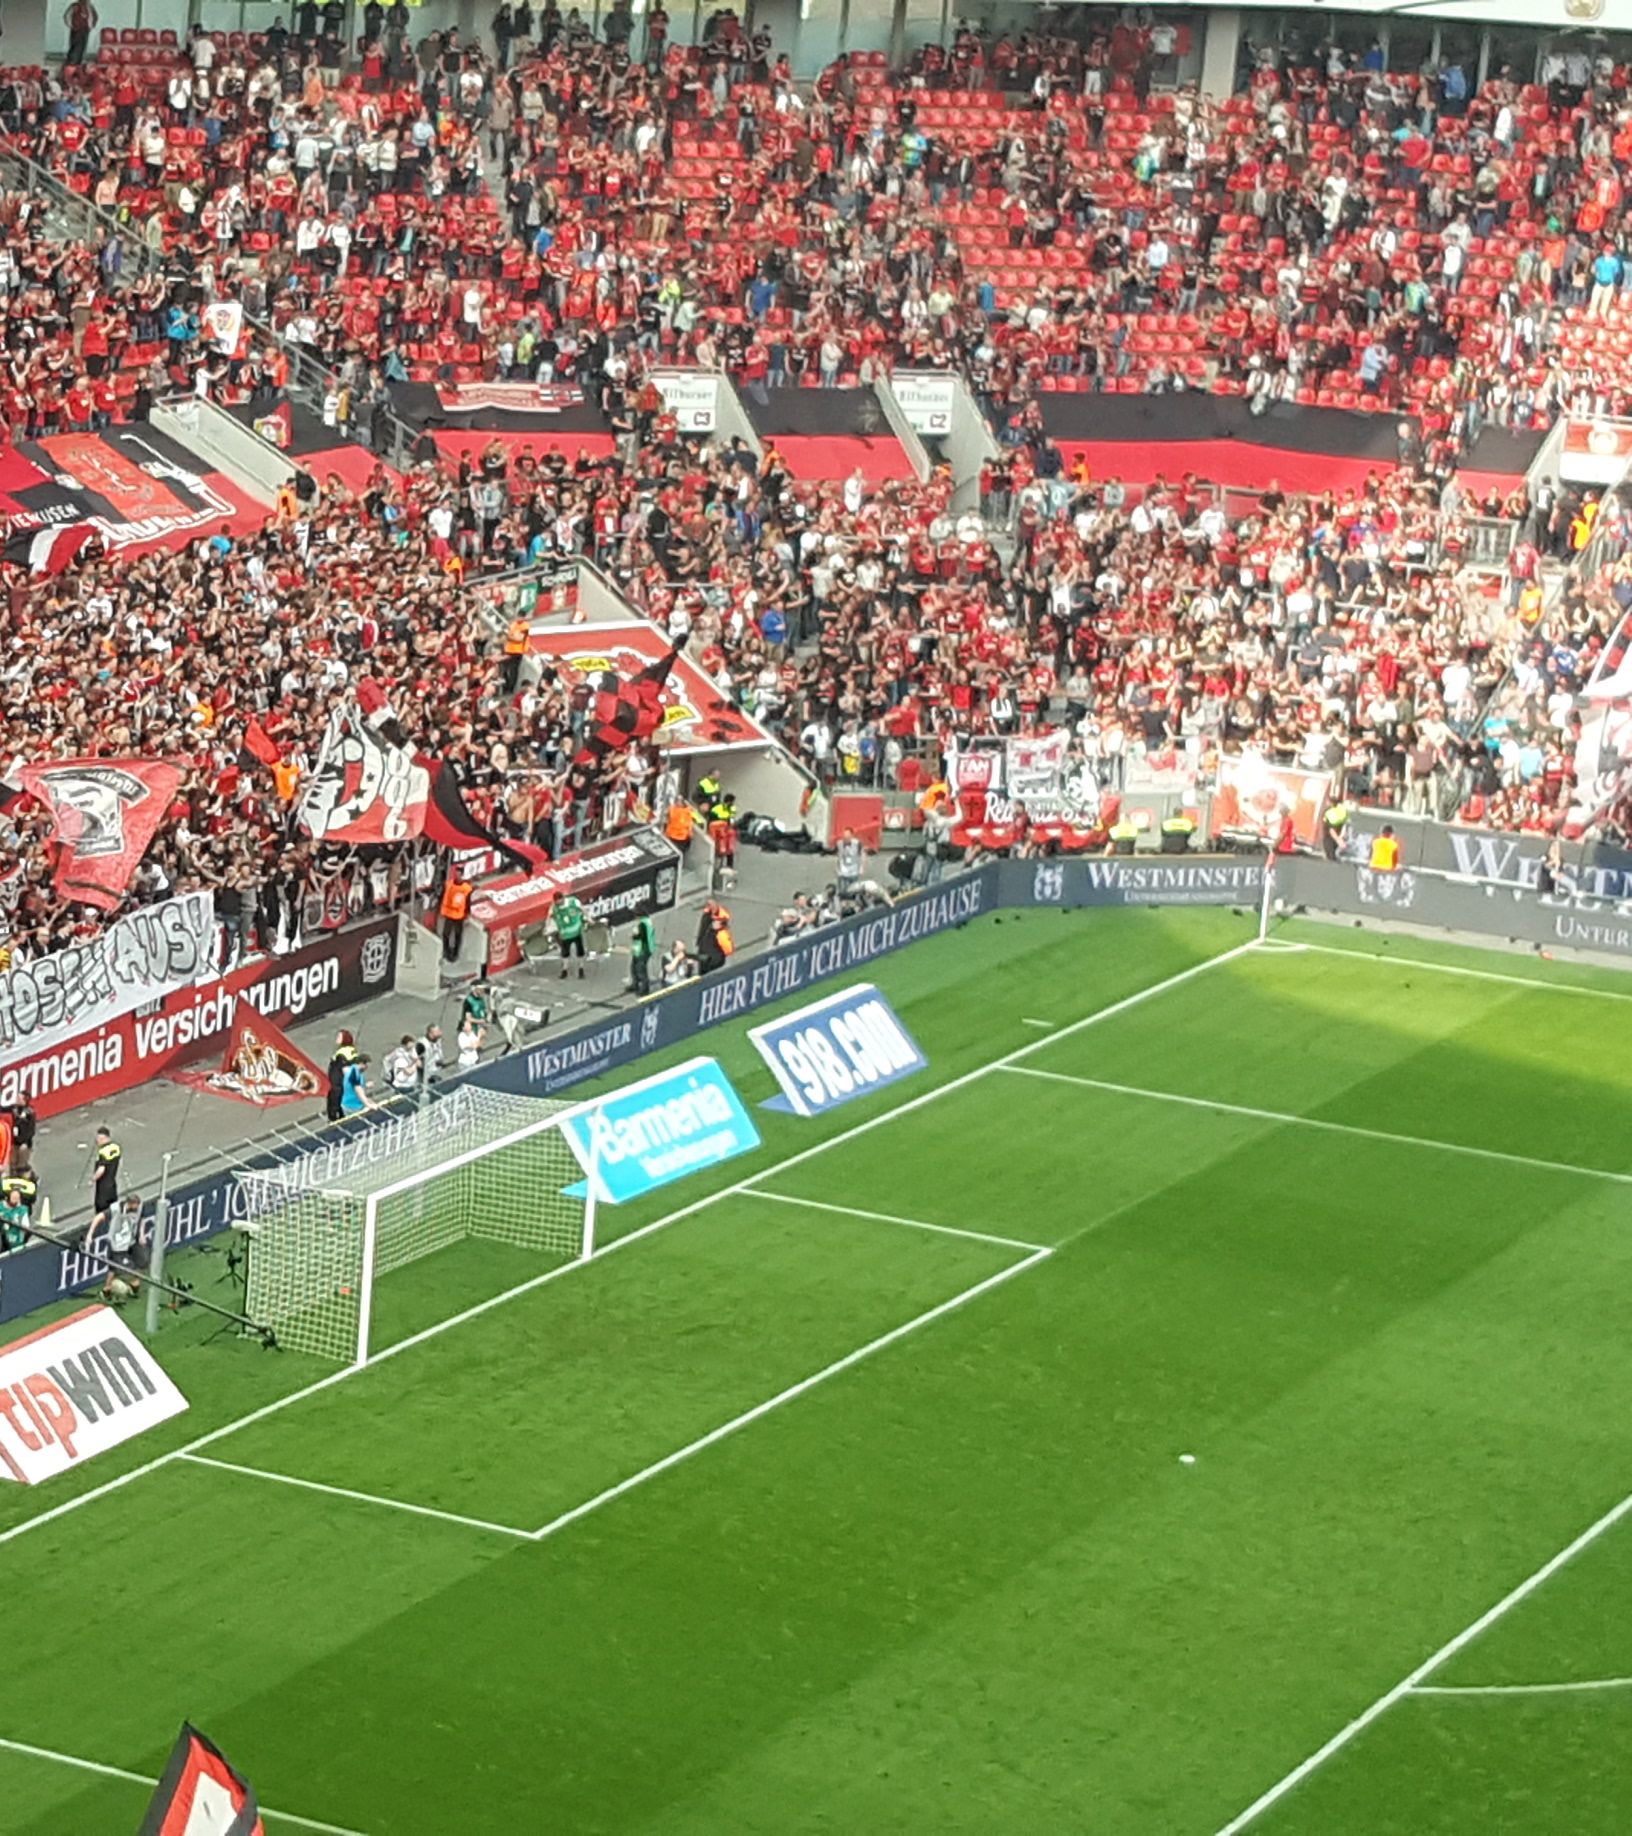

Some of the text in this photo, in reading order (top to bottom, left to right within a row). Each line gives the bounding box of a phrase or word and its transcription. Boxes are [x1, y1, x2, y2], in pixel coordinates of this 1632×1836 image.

[699, 976, 749, 1025] HIER
[809, 941, 843, 978] ICH
[841, 921, 898, 965] MICH
[898, 879, 983, 941] ZUHAUSE
[527, 1021, 632, 1084] WESTMINSTER
